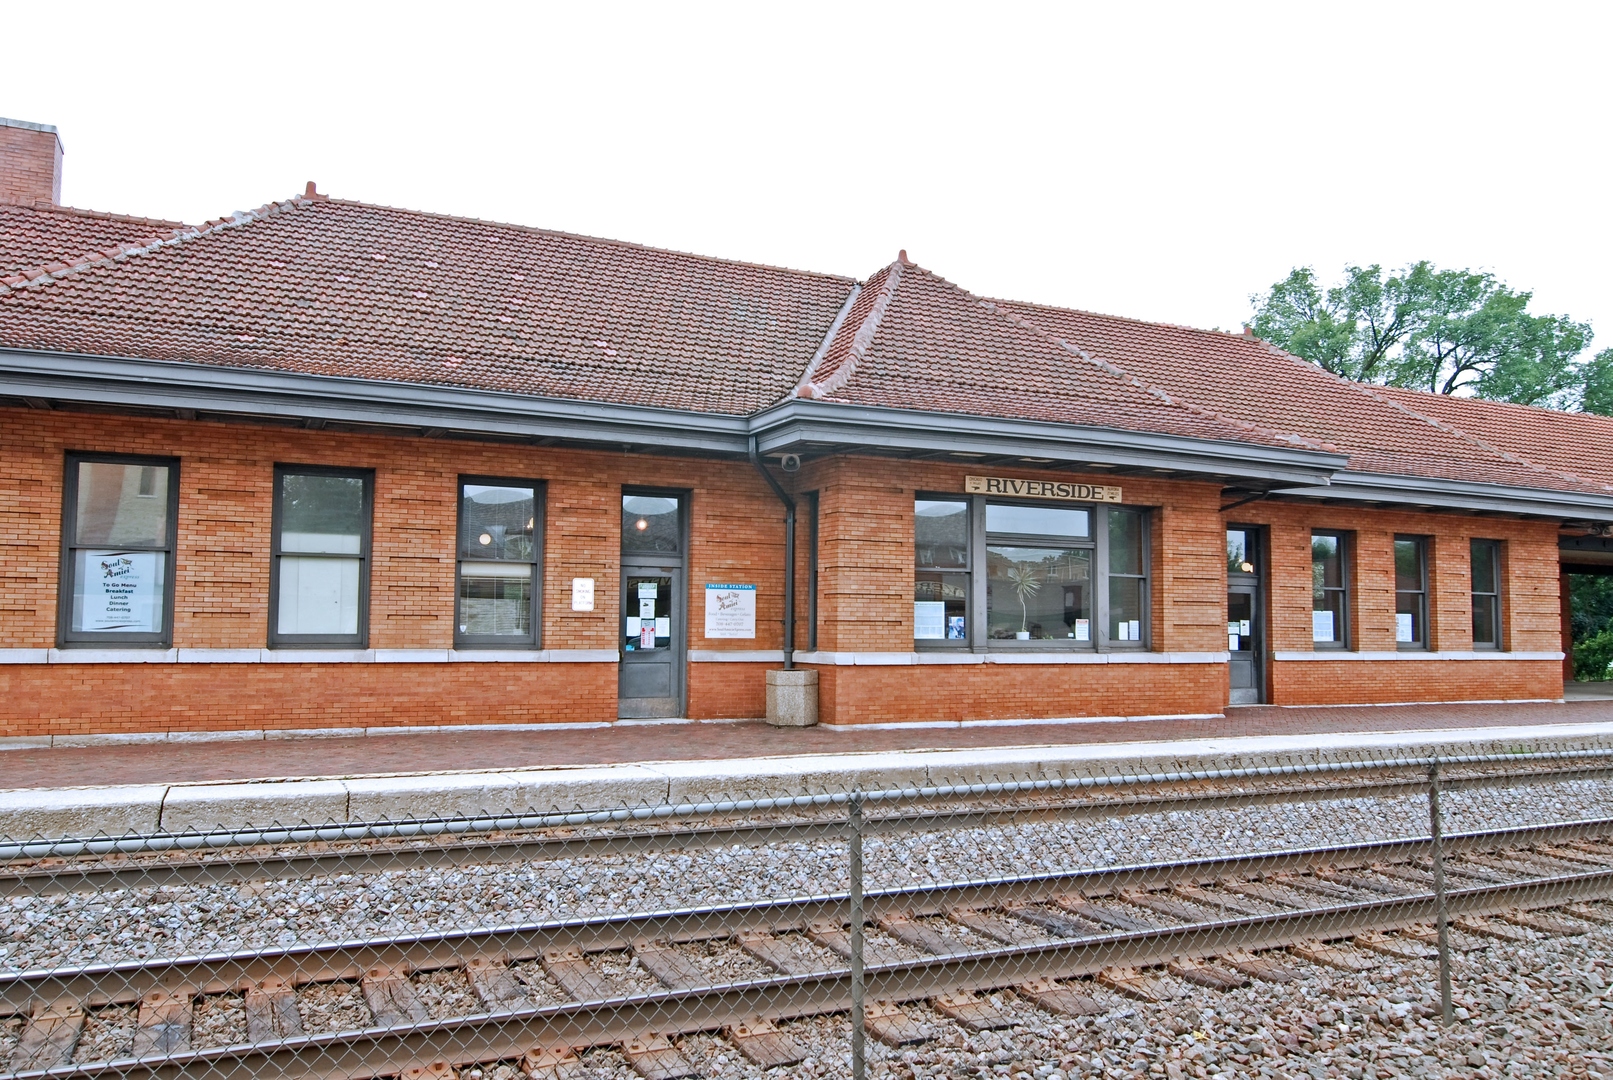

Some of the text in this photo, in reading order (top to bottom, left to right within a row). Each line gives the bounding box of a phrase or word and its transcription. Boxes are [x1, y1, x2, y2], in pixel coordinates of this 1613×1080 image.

[986, 478, 1104, 500] RIVERSIDE
[101, 559, 120, 570] Soul
[104, 566, 130, 578] Amici
[716, 592, 730, 602] Soul
